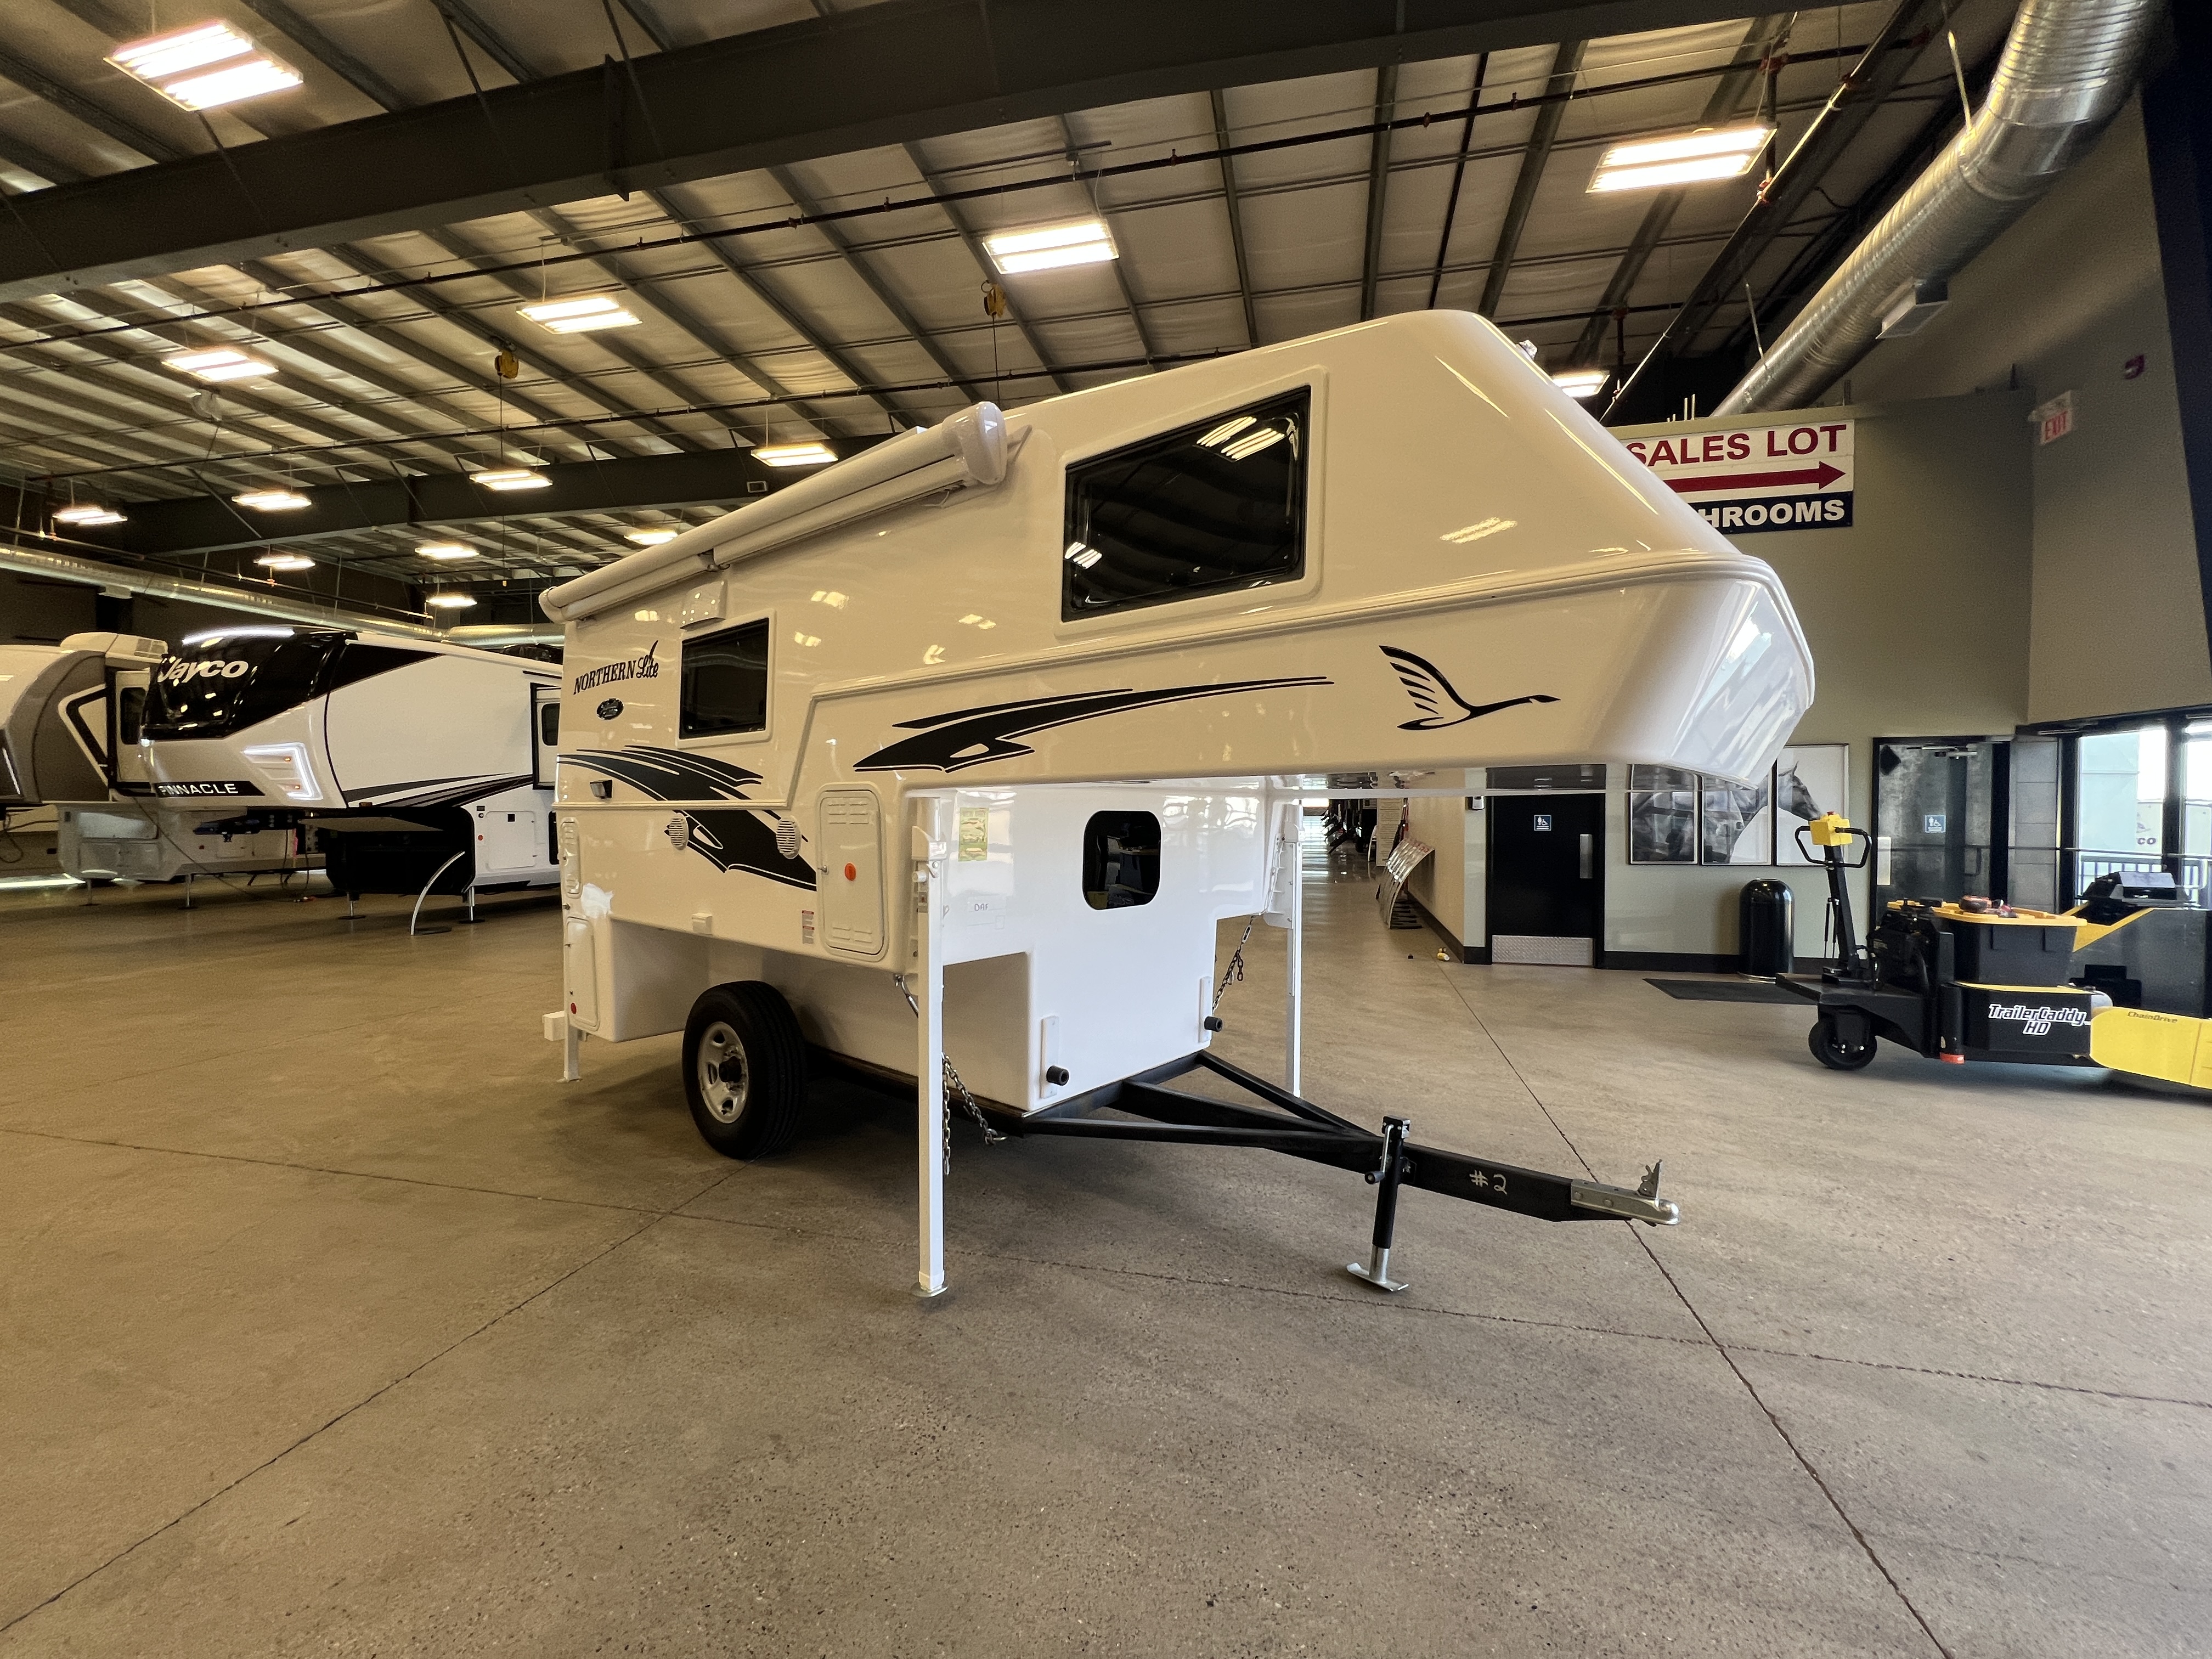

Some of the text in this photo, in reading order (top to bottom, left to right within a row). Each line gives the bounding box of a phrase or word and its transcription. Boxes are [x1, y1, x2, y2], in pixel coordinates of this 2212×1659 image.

[2045, 411, 2068, 440] EXIT
[1626, 424, 1847, 467] SALES LOT
[1698, 499, 1845, 528] HROOMS
[157, 658, 249, 684] Jayco
[573, 641, 659, 695] NORTHERN Lite
[158, 783, 239, 795] PINNACLE
[1988, 1003, 2087, 1027] TrailerCaddy
[2022, 1020, 2052, 1036] HD
[2128, 1011, 2178, 1023] ChainDrive
